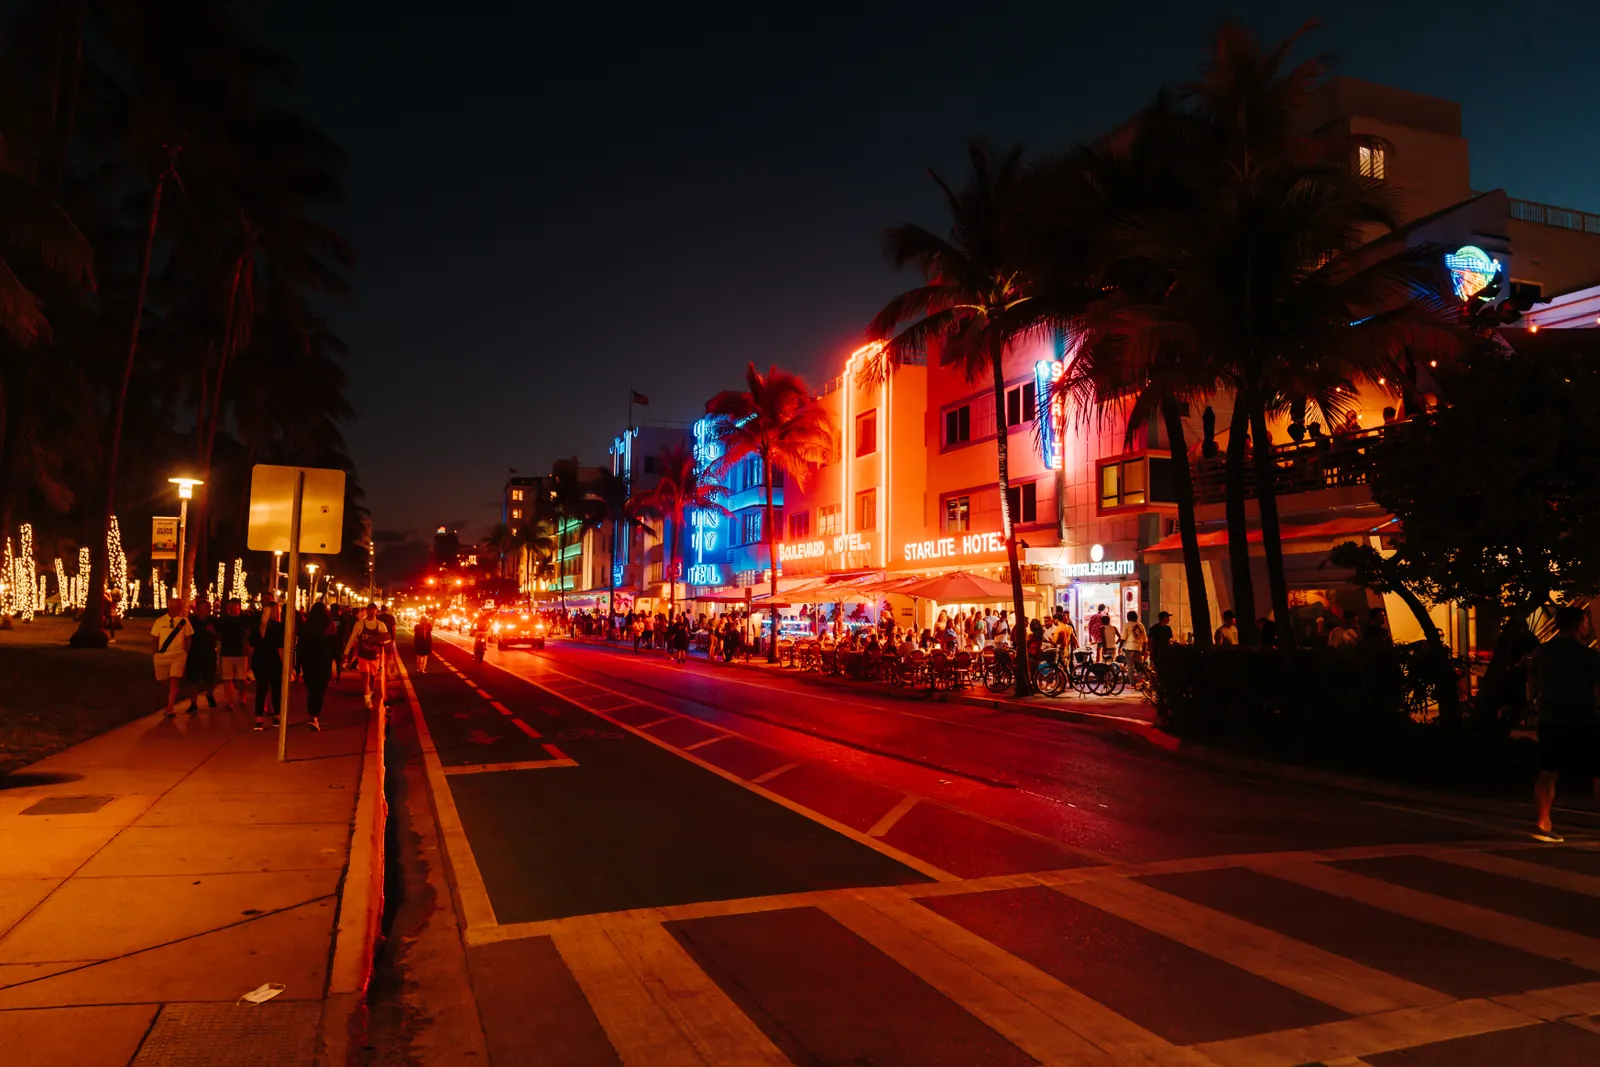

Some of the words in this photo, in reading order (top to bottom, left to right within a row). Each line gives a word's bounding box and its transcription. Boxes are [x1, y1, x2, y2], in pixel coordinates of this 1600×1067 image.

[1051, 361, 1063, 469] SRLITE
[778, 540, 825, 562] BOULEVARD
[834, 532, 866, 554] HOTEL
[904, 537, 956, 561] STARLITE
[962, 531, 1006, 555] HOTEL
[1103, 560, 1134, 575] GELATO
